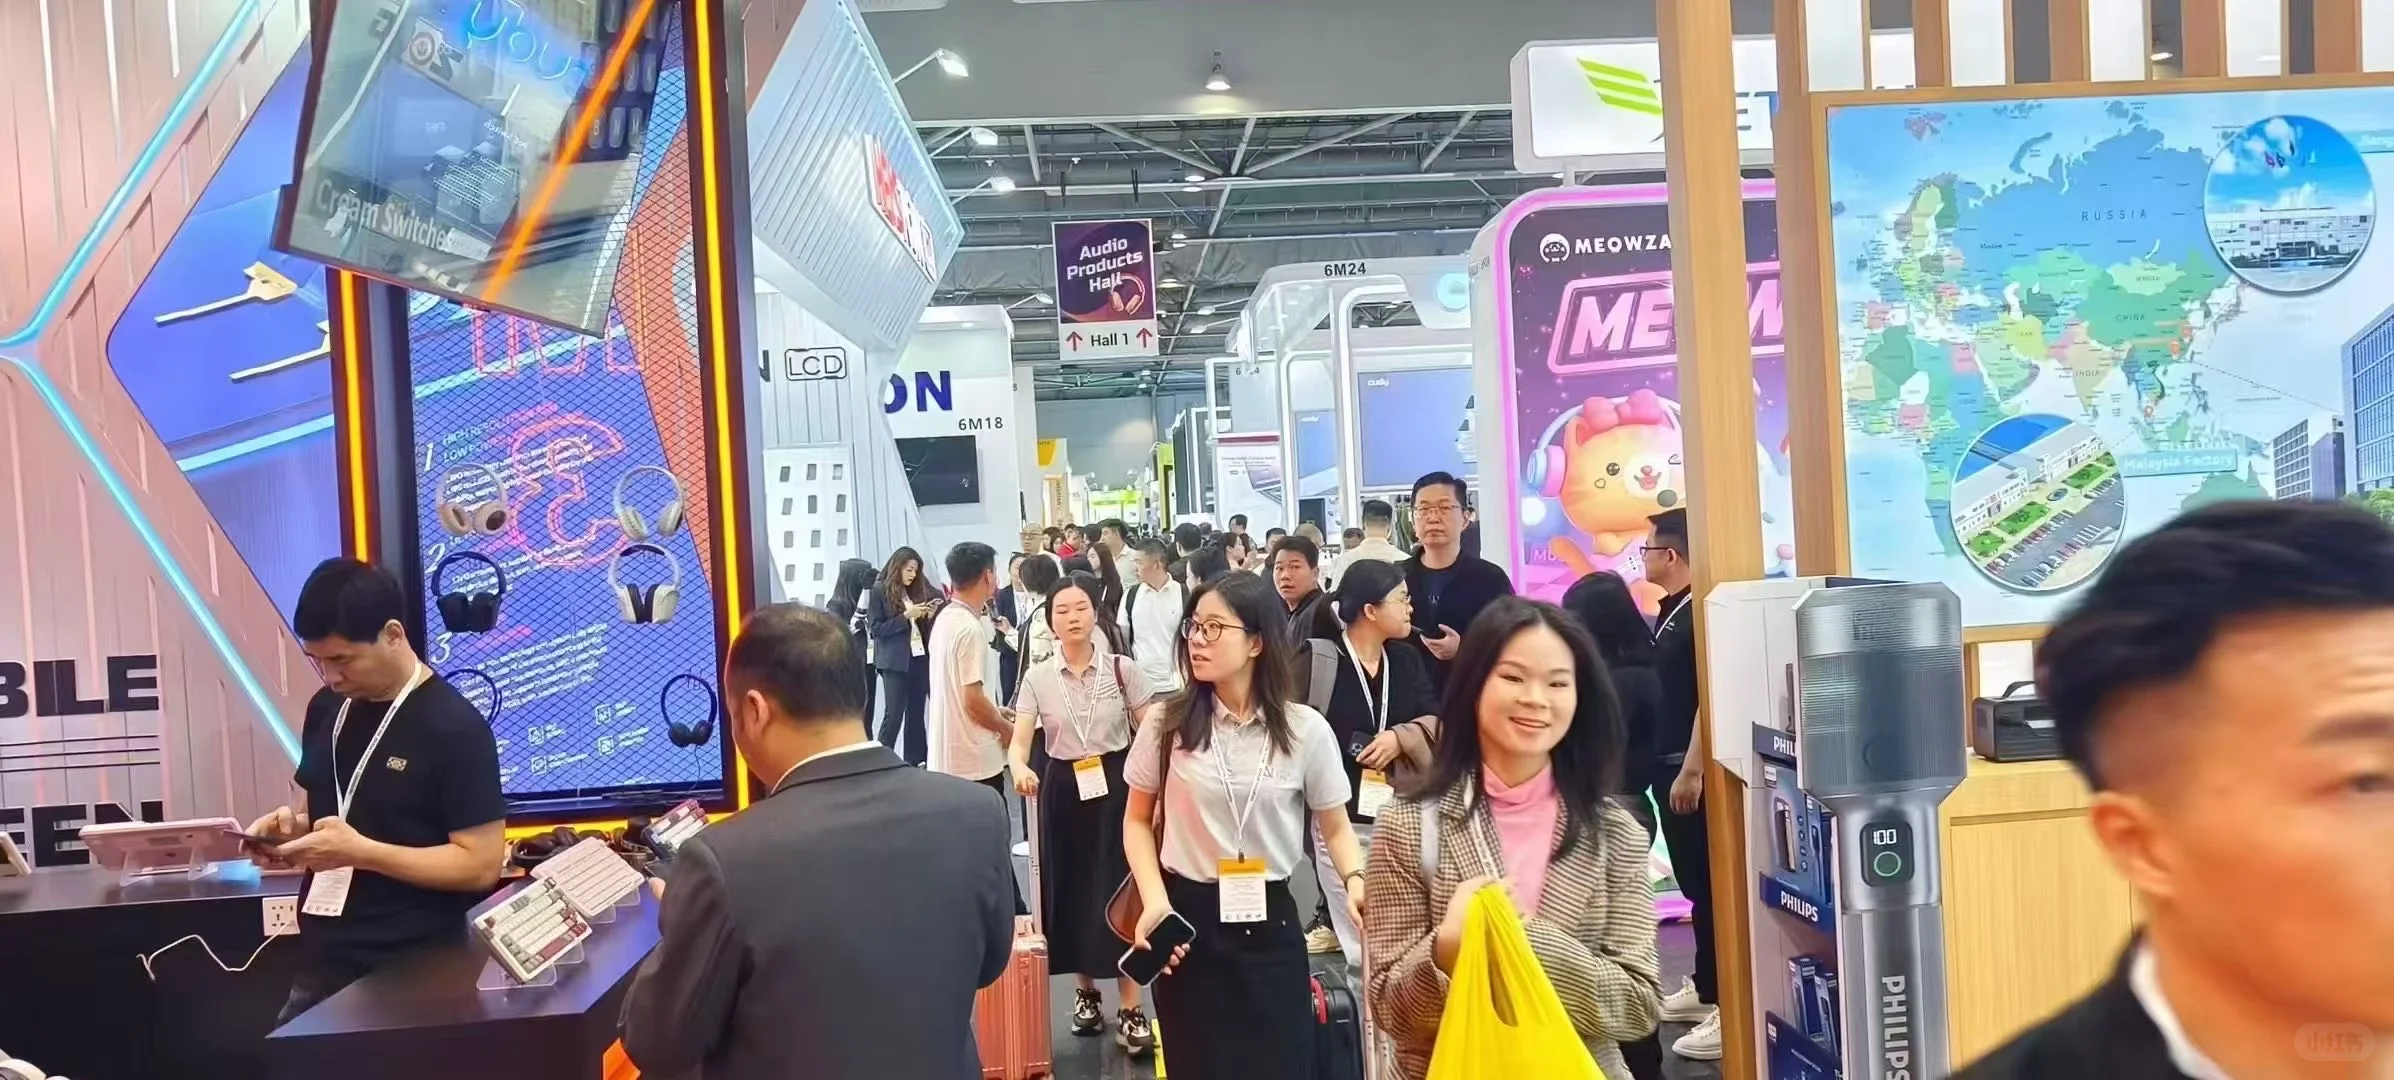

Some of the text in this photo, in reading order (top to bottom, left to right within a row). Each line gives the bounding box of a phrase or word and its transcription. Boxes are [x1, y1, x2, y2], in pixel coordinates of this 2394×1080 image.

[315, 178, 381, 229] Cream
[2081, 208, 2147, 221] RUSSIA
[1079, 237, 1129, 261] Audio
[1067, 251, 1144, 281] Products
[1323, 262, 1367, 277] 6M24
[1089, 272, 1124, 293] Hall
[2115, 313, 2146, 322] CHINA
[1091, 332, 1130, 347] Hall 1
[788, 355, 843, 377] LCD
[2075, 369, 2101, 378] INDIA
[957, 416, 1004, 432] 6M18
[1872, 828, 1897, 845] 100
[1780, 890, 1819, 923] PHILIPS
